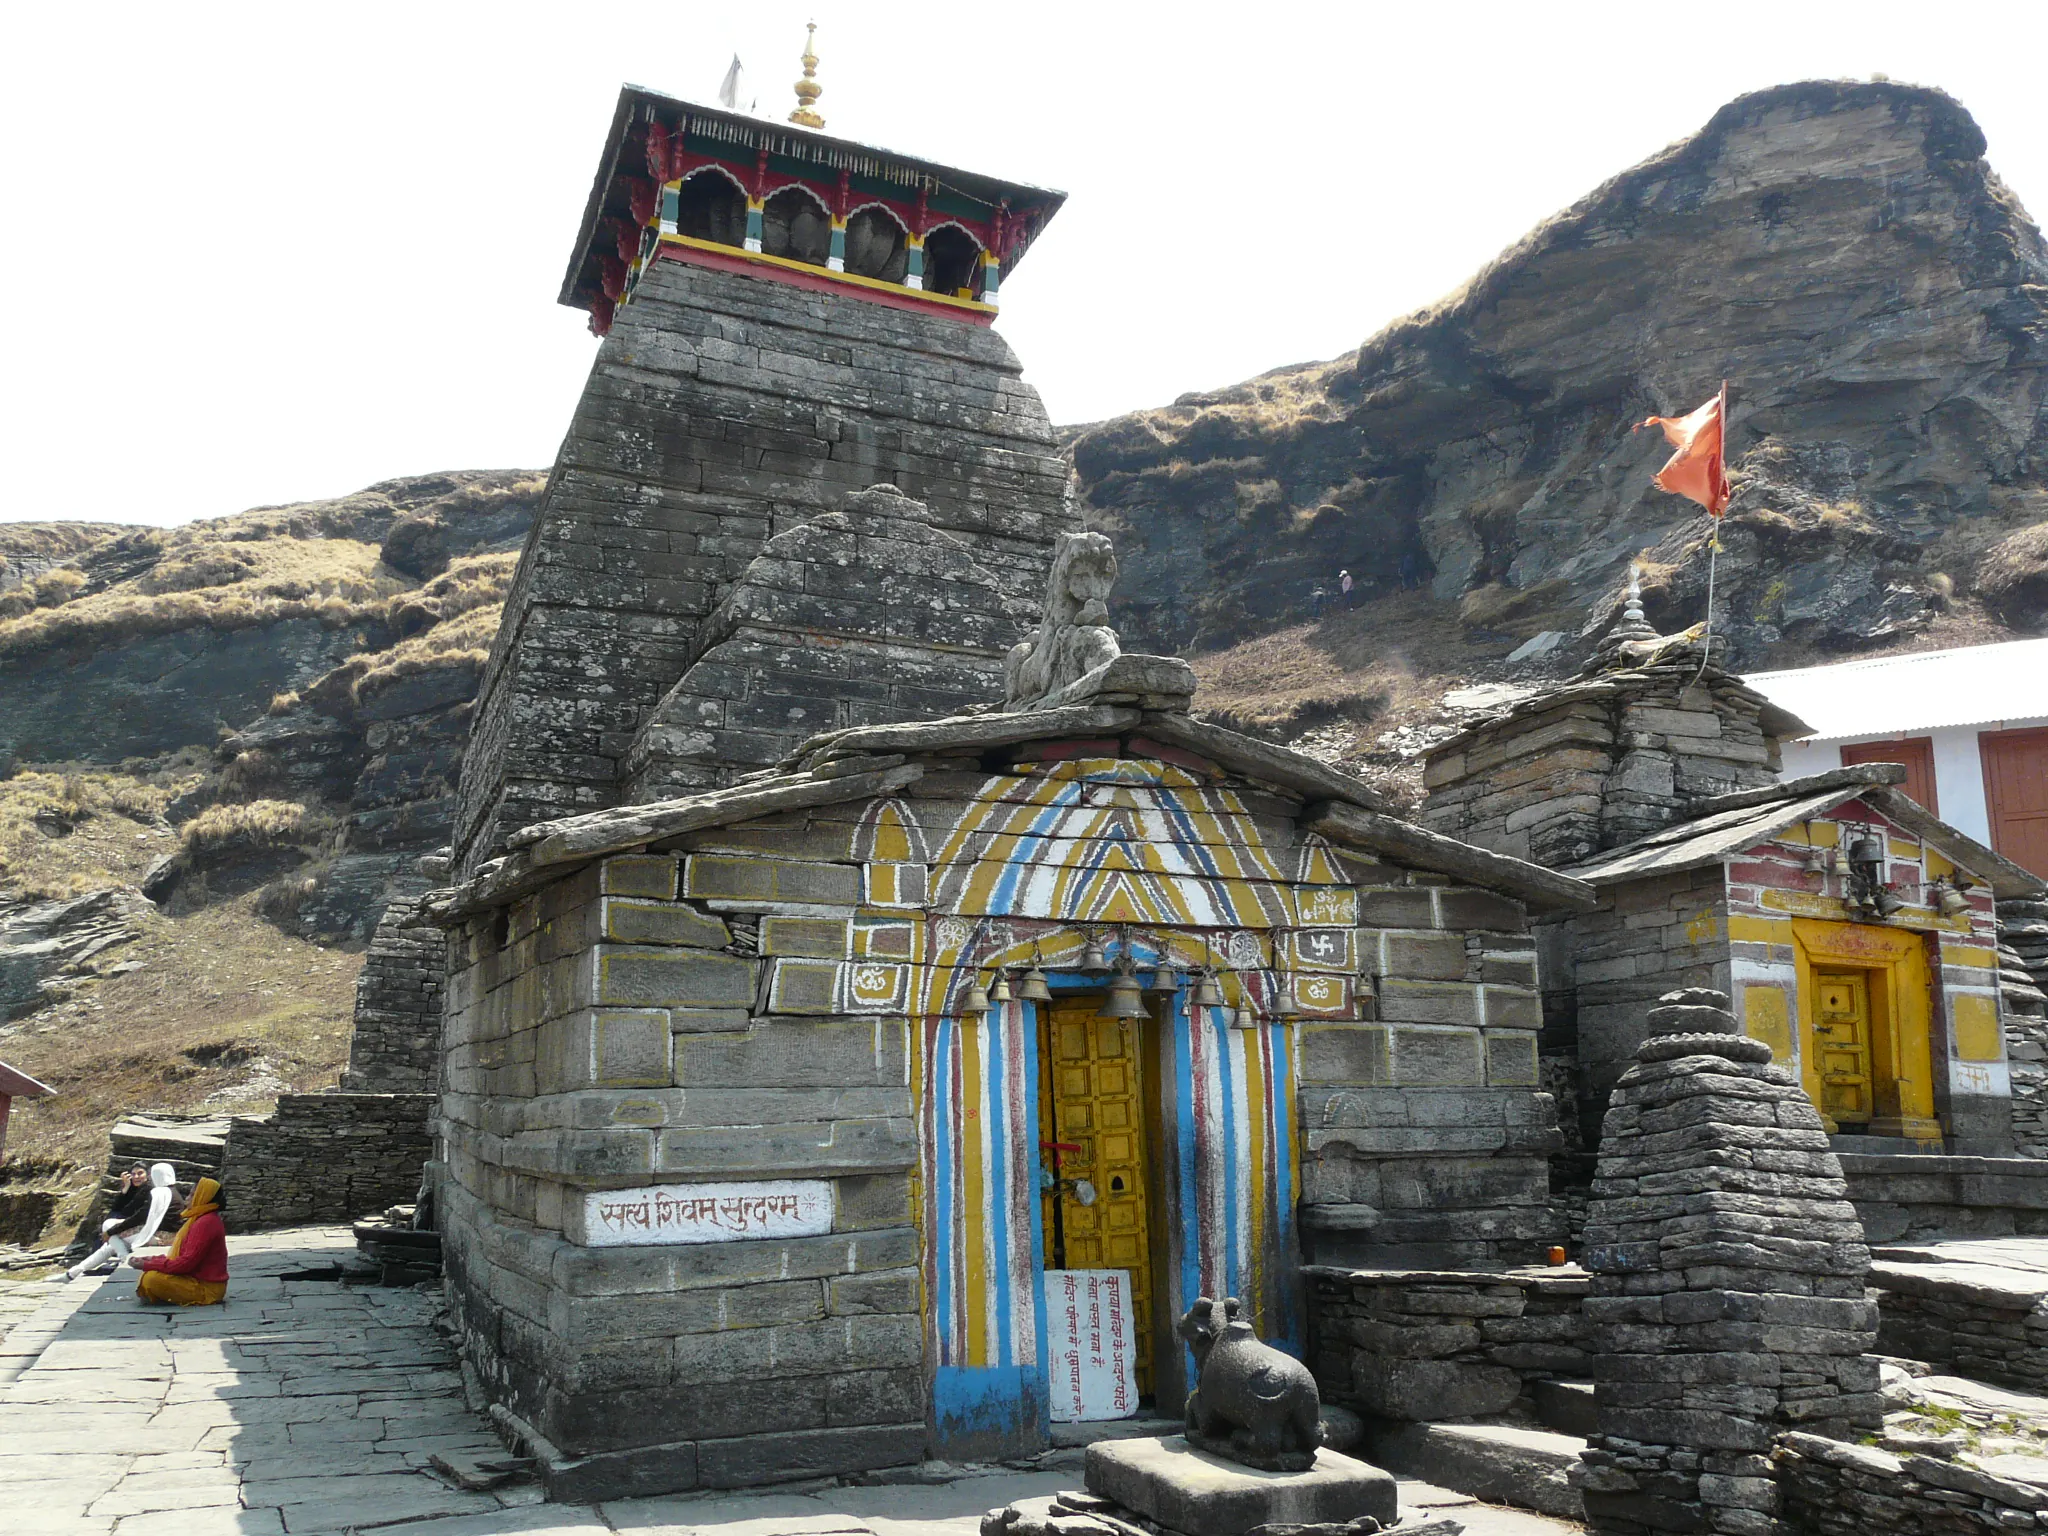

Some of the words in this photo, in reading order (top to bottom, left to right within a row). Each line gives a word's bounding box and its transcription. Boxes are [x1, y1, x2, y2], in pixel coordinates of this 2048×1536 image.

[600, 1194, 650, 1232] सत्यं
[654, 1191, 723, 1228] शिवम्
[1063, 1274, 1079, 1302] मन्दिर
[1088, 1276, 1101, 1300] लेना
[1102, 1276, 1120, 1309] कृपया
[1064, 1305, 1080, 1335] परिसर
[1110, 1309, 1125, 1338] मन्दिर
[1090, 1331, 1102, 1354] मना
[1113, 1339, 1127, 1352] के
[1114, 1384, 1129, 1411] फोटो
